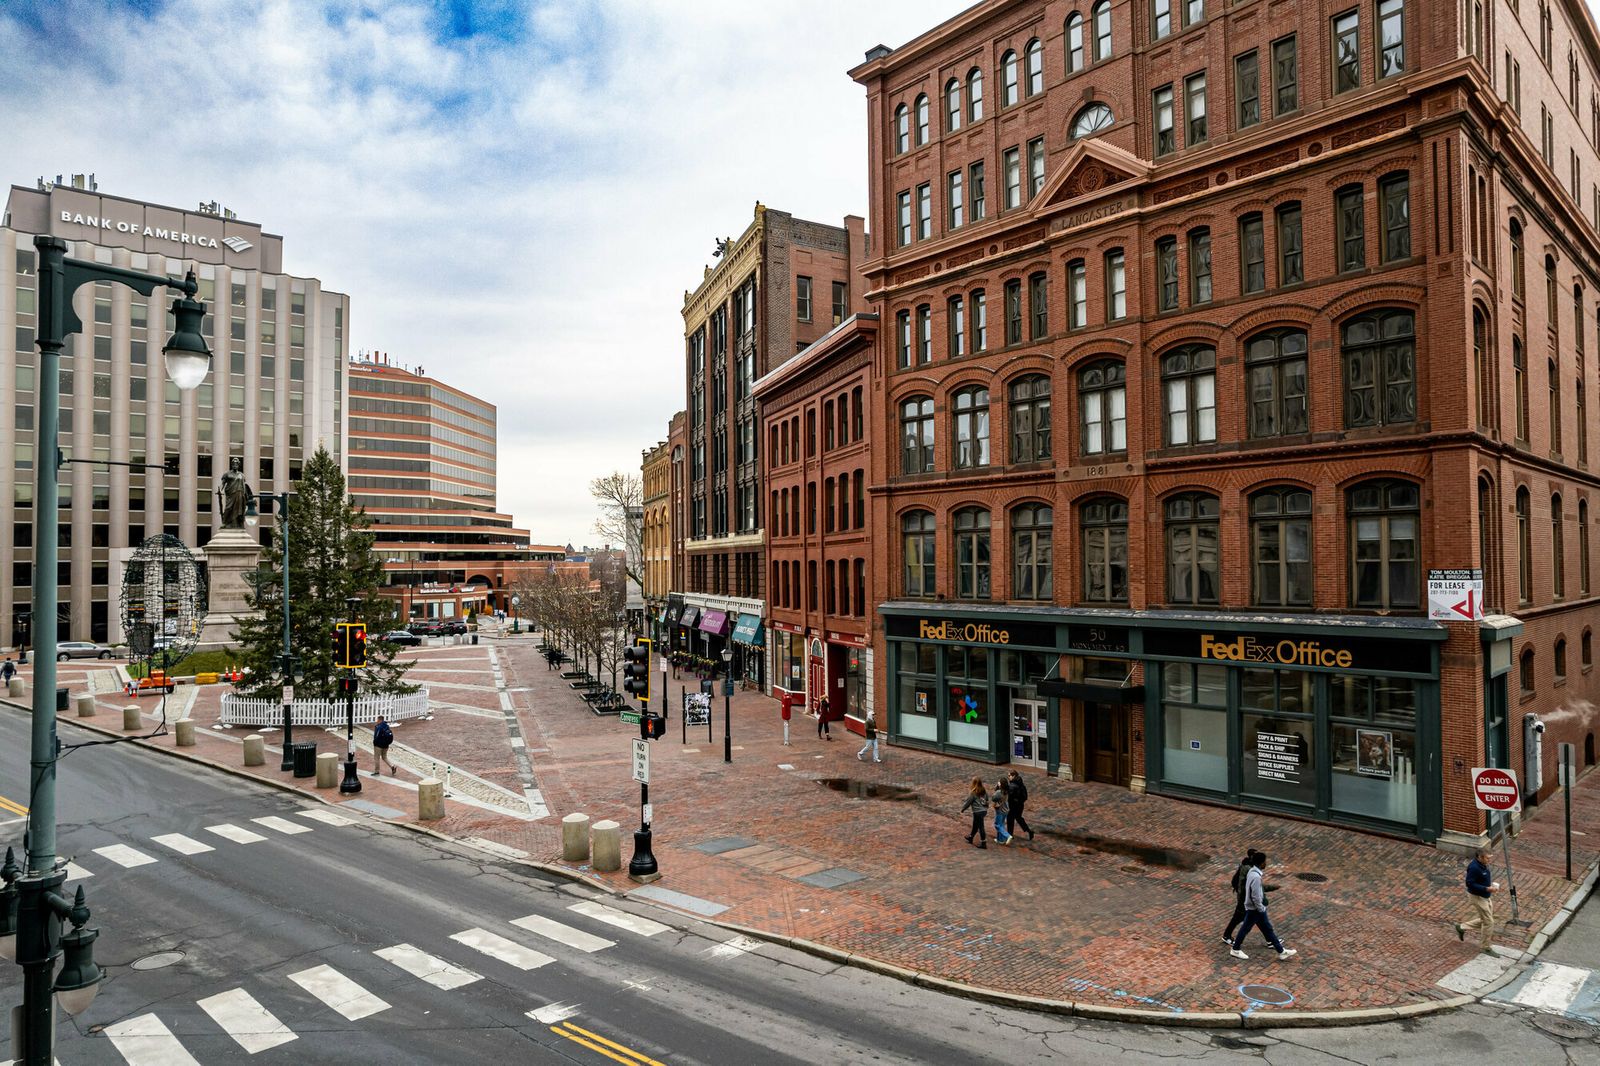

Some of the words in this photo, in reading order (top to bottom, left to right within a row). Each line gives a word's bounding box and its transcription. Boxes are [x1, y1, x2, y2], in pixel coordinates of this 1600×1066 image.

[1062, 201, 1124, 229] LANCASTER
[60, 210, 112, 230] BANK
[116, 220, 139, 234] OF
[142, 226, 219, 249] AMERICA
[1086, 466, 1108, 476] 1881
[1430, 581, 1443, 590] FOR
[1444, 581, 1466, 590] LEASE
[919, 619, 965, 641] FedEx
[964, 623, 1010, 644] Office
[1090, 629, 1106, 642] 50
[1072, 642, 1113, 651] MONUMENT
[1201, 634, 1275, 663] FedEx
[1276, 639, 1353, 668] Office
[637, 742, 645, 752] NO
[636, 752, 646, 761] TURN
[638, 762, 644, 770] ON
[637, 770, 645, 779] RED
[1485, 794, 1510, 803] ENTER
